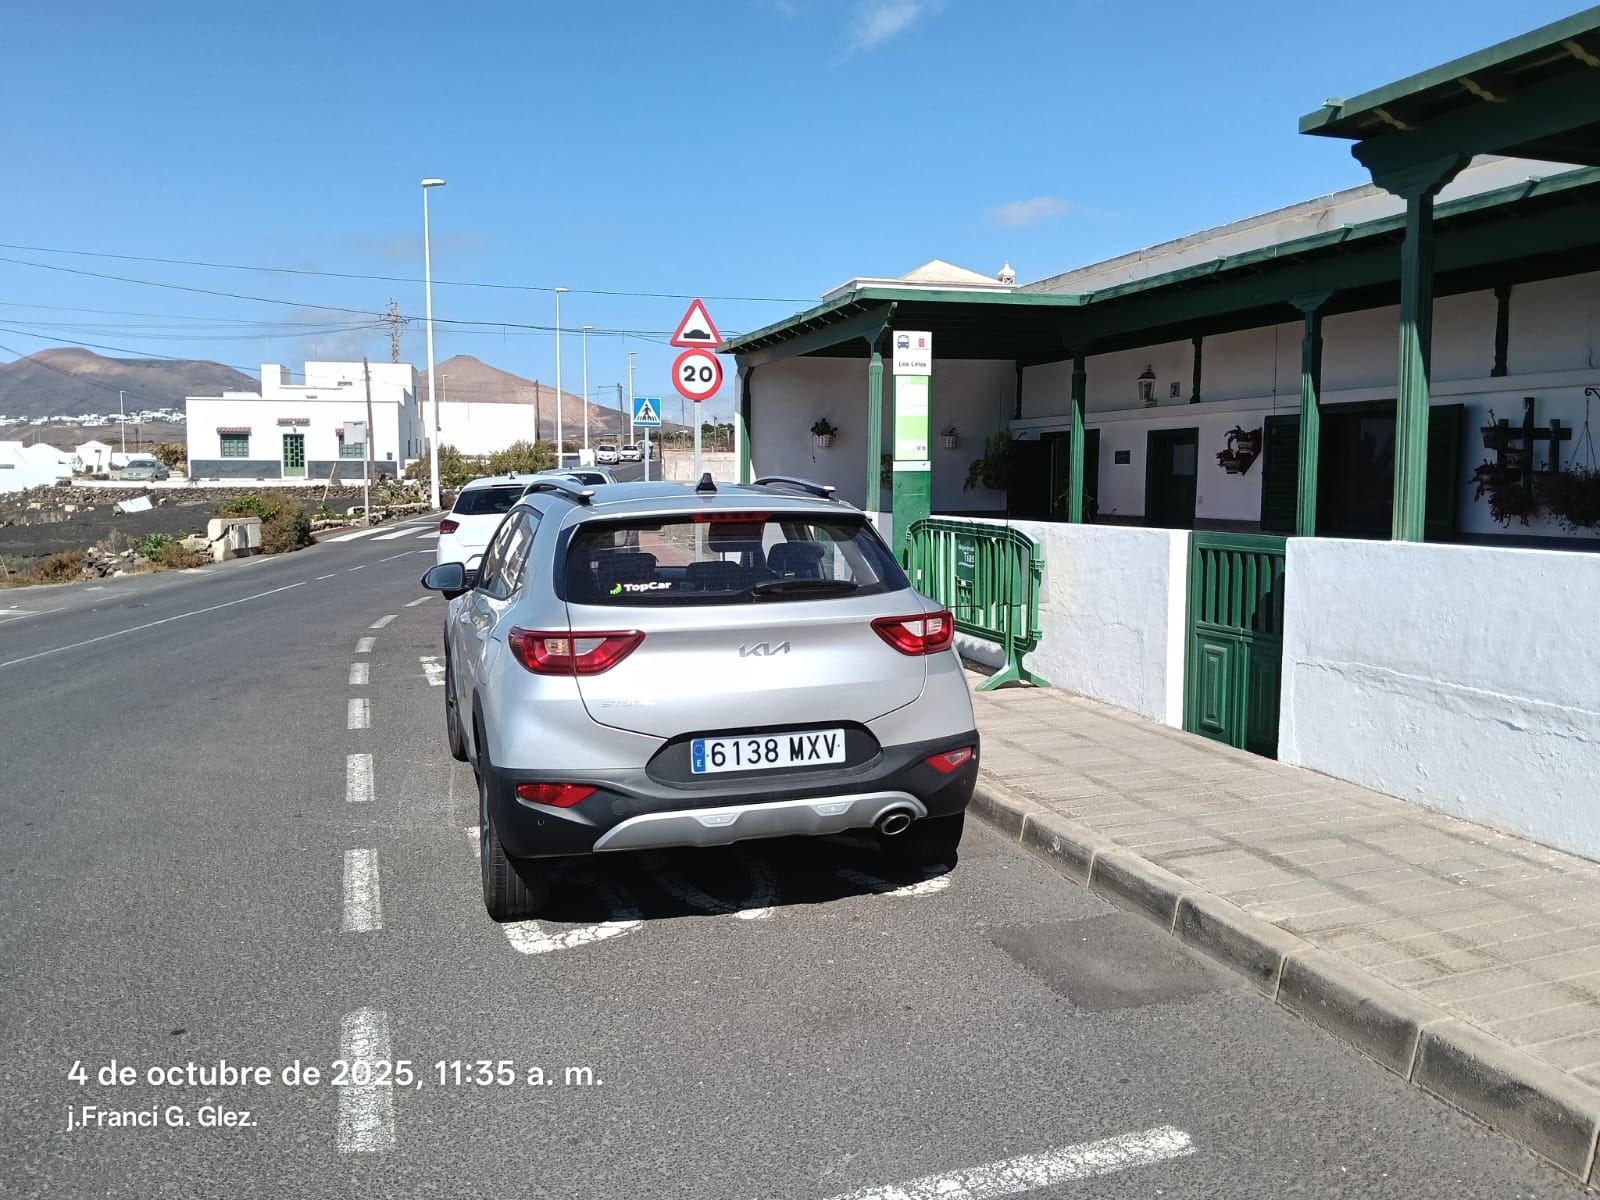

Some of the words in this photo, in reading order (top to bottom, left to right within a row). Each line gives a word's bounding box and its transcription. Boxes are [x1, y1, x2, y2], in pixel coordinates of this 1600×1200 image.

[683, 365, 713, 382] 20
[623, 581, 672, 592] TopCar
[738, 640, 791, 658] KIA
[711, 738, 779, 767] 6138
[789, 733, 837, 761] MXV
[696, 759, 702, 767] E
